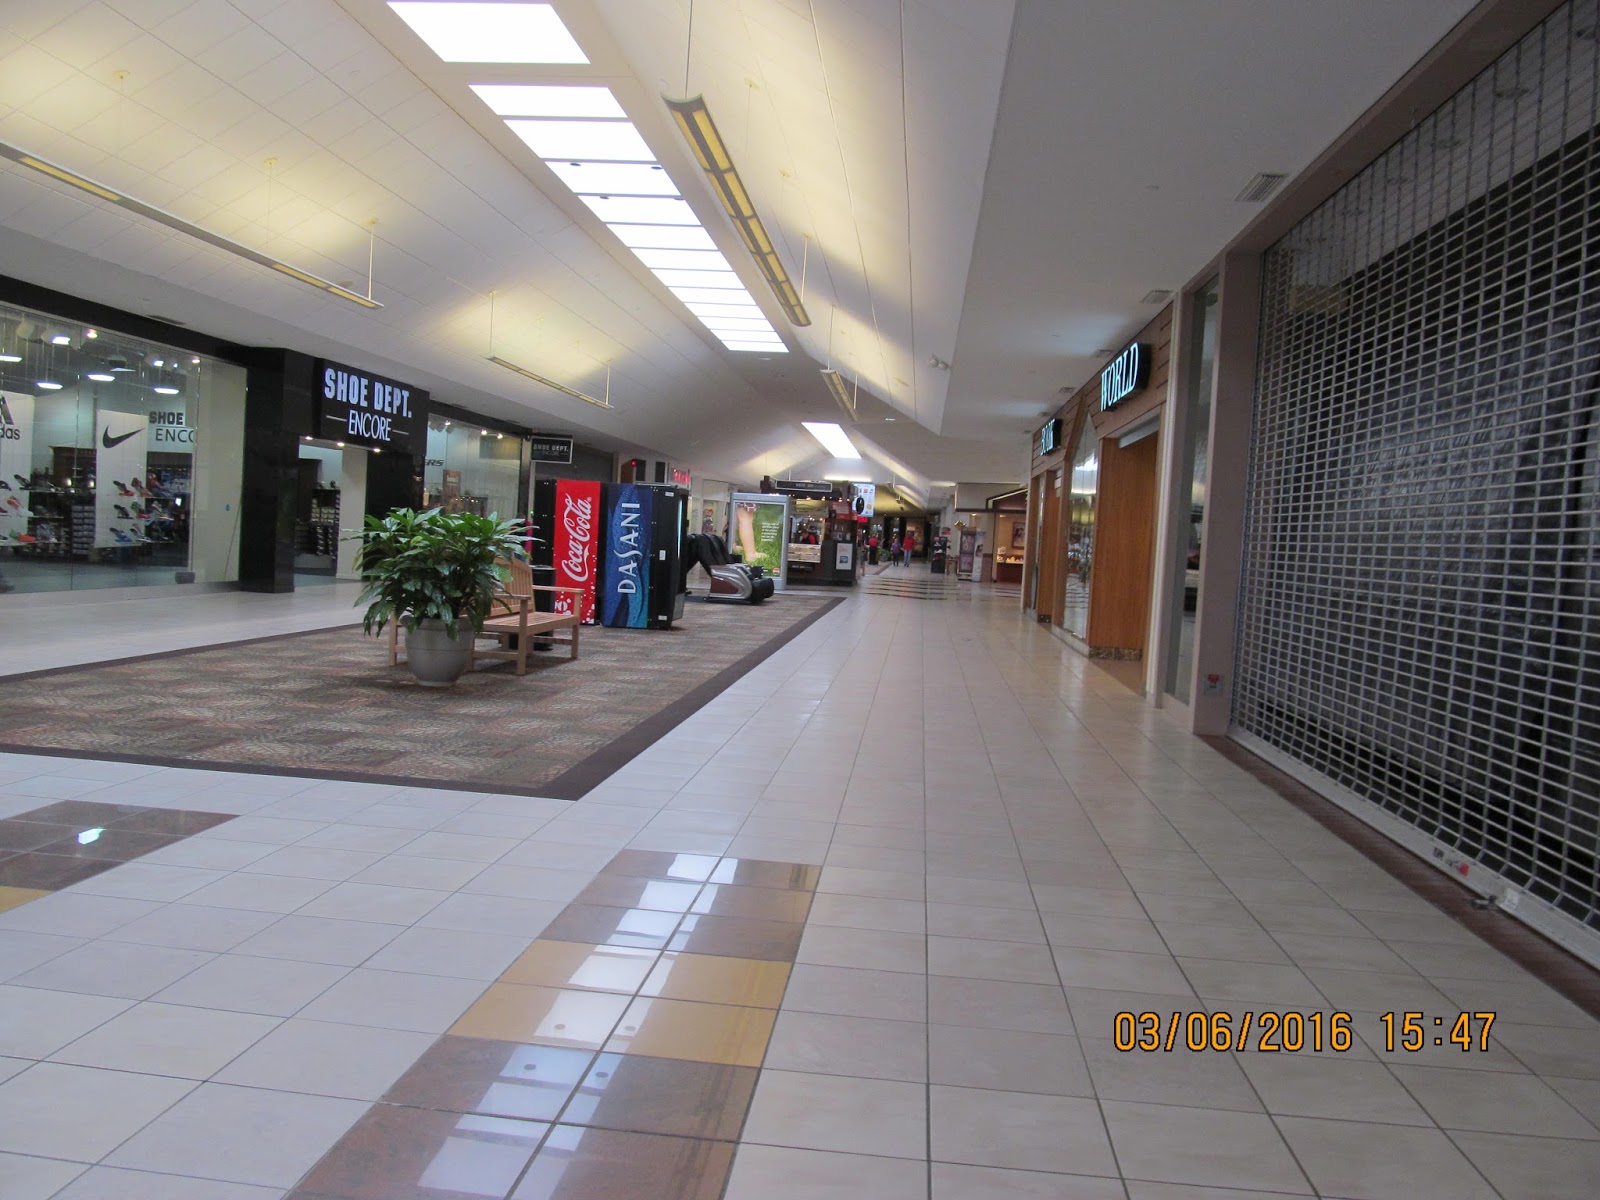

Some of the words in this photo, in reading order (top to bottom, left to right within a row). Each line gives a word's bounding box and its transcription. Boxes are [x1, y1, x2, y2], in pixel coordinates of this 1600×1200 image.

[324, 368, 369, 407] SHOE
[373, 381, 412, 418] DEPT.
[1100, 342, 1139, 412] WORLD
[149, 411, 184, 426] SHOE
[348, 409, 392, 441] ENCORE
[561, 492, 592, 582] Coca-Cola
[617, 502, 643, 594] DASANI
